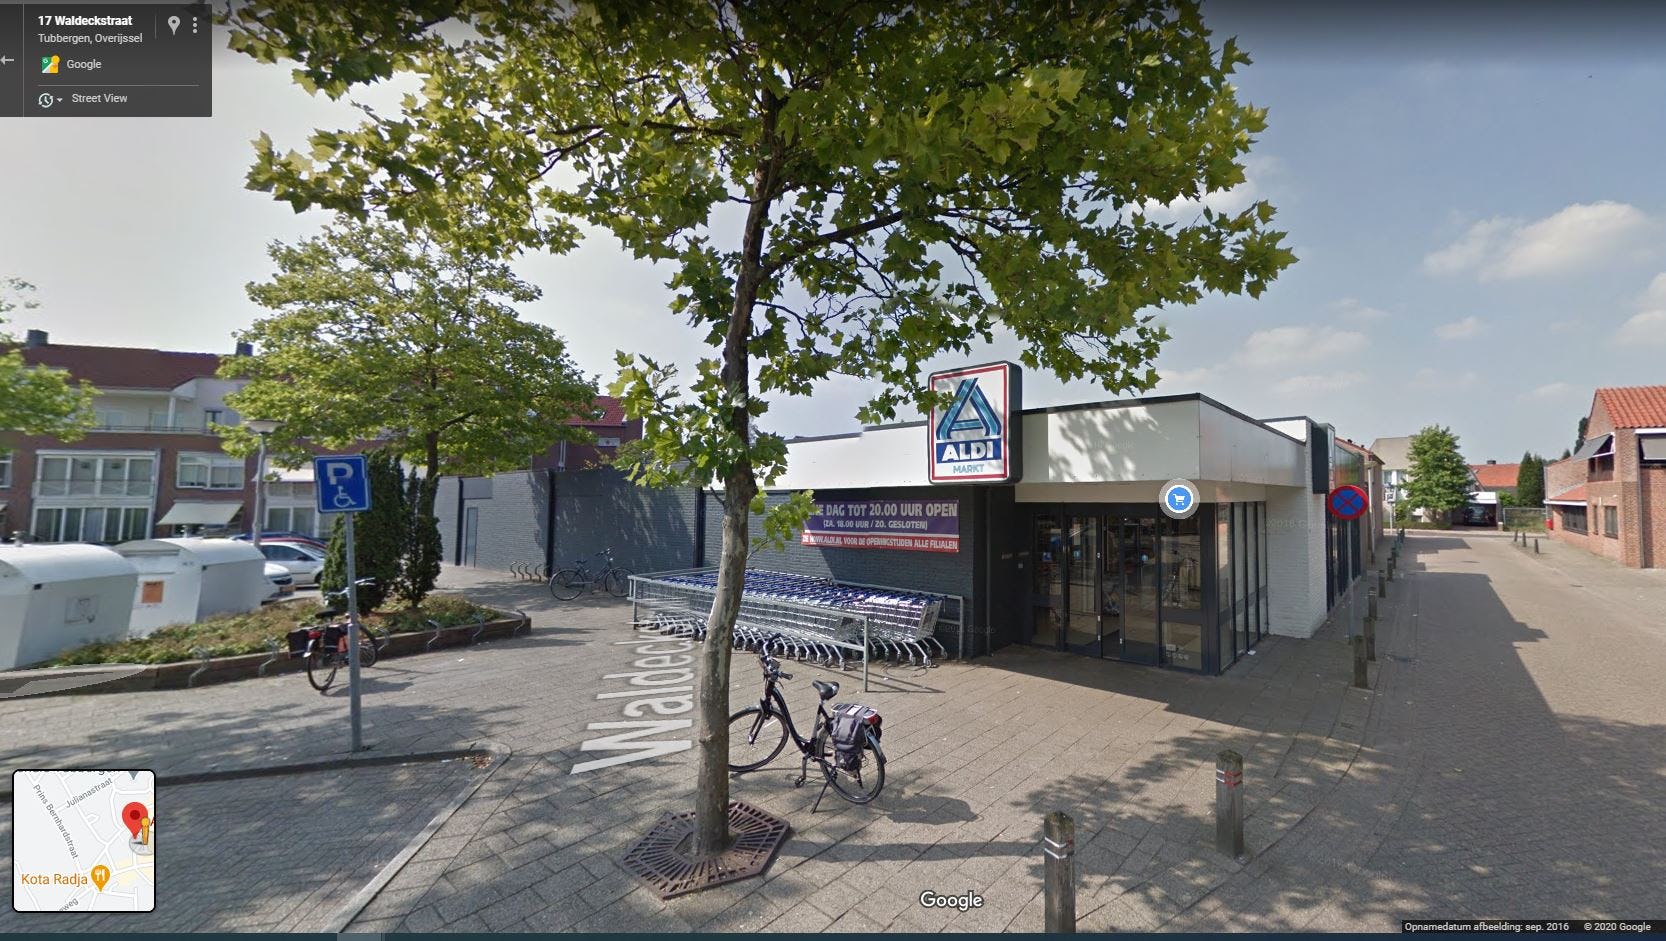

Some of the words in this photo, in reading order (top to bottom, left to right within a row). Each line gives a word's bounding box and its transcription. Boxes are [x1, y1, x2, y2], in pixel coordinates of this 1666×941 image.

[941, 441, 994, 462] ALDI
[326, 462, 354, 486] P
[952, 464, 984, 474] MARKT
[826, 504, 845, 517] DAG
[848, 504, 867, 517] TOT
[869, 503, 897, 517] 20.00
[900, 503, 923, 517] UUR
[925, 503, 958, 517] OPEN
[855, 520, 869, 529] UUR
[875, 520, 887, 529] ZO.
[888, 520, 928, 530] GESLOTEN)
[843, 536, 858, 545] VOOR
[858, 537, 866, 545] DE
[866, 537, 913, 547] OPENINGSTIJDEN
[914, 539, 929, 548] ALLE
[929, 540, 958, 549] FILIALEN
